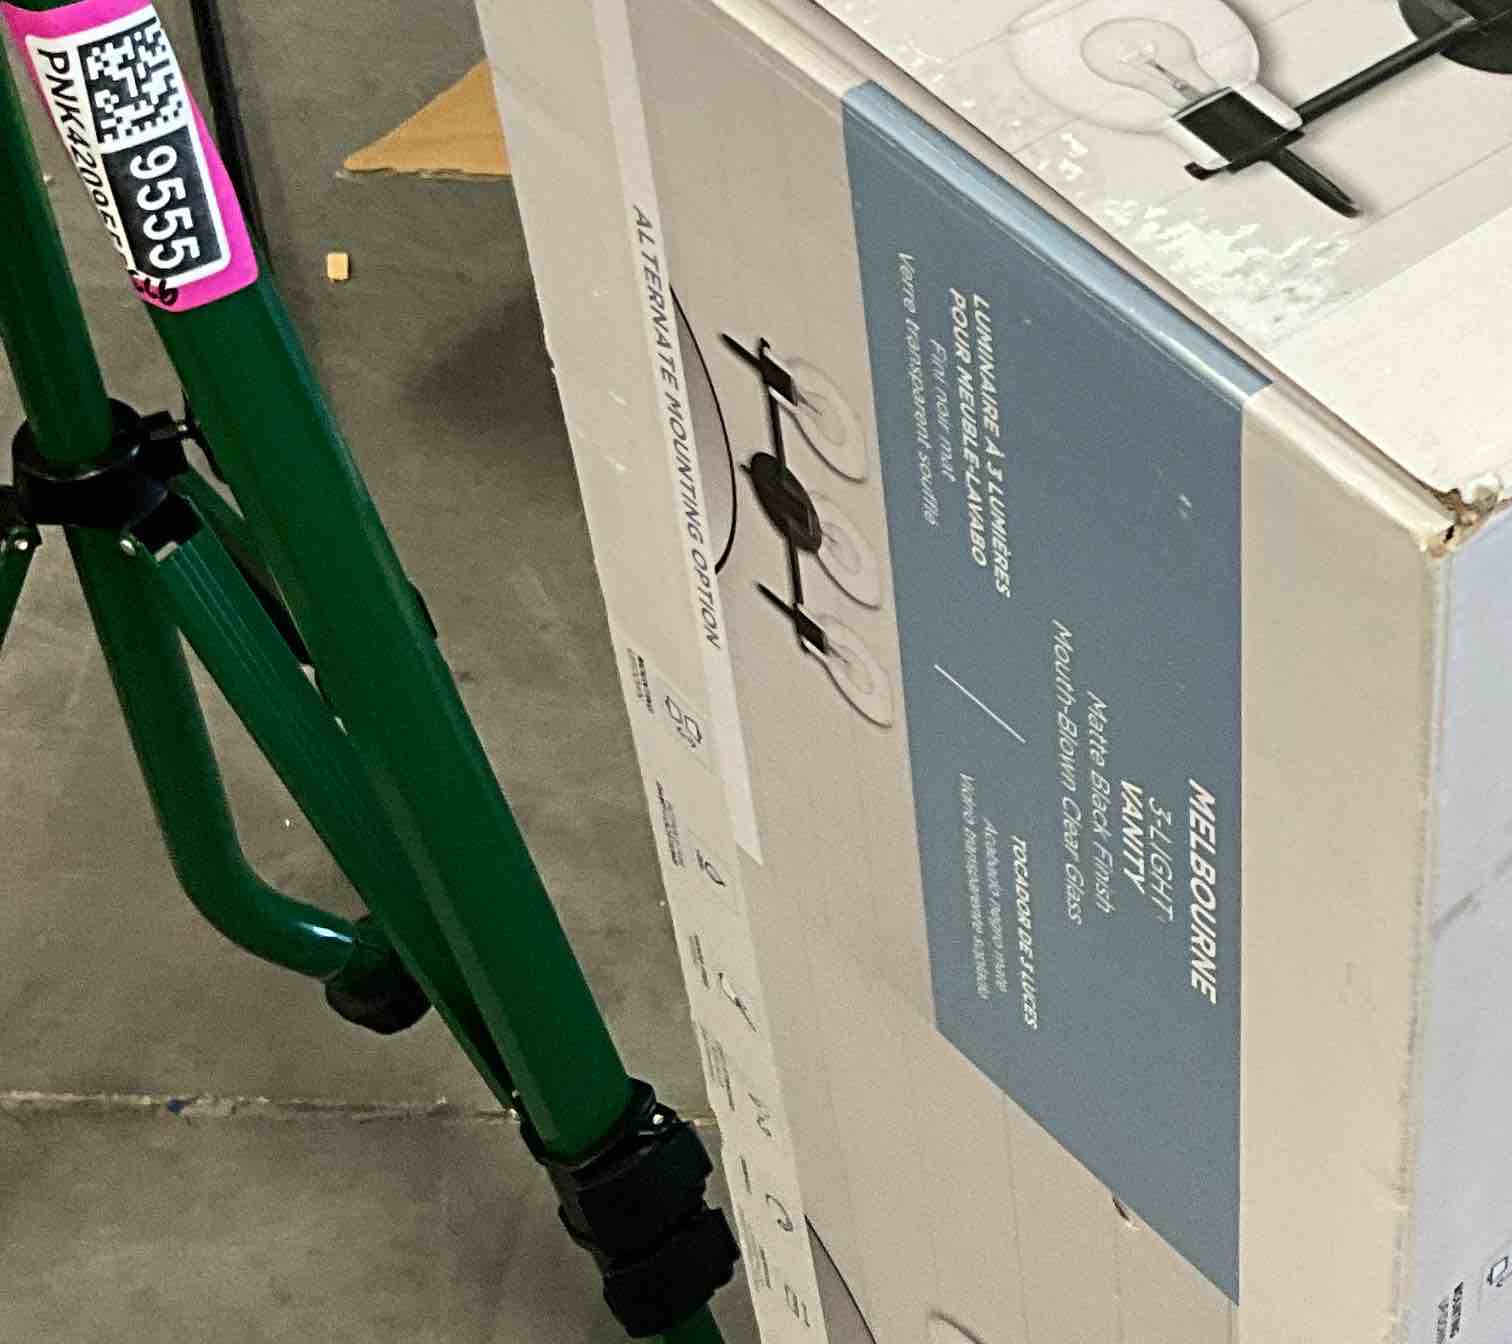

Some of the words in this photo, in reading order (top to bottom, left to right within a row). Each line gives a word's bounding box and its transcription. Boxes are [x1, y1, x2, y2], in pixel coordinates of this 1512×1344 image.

[129, 144, 201, 270] 9555
[898, 246, 918, 319] Verre
[929, 335, 948, 393] Fini
[950, 286, 970, 363] POUR
[972, 290, 998, 438] LUMINAIRE
[902, 312, 930, 453] transparent
[934, 387, 952, 436] noir
[633, 202, 678, 393] ALTERNATE
[664, 389, 704, 548] MOUNTING
[690, 544, 721, 652] OPTION
[938, 431, 956, 486] mat
[956, 364, 986, 571] MEUBLE-LAVABO
[983, 433, 1003, 466] À
[917, 447, 938, 532] soufflé
[985, 457, 1002, 483] 3
[987, 477, 1012, 603] LUMIÈRES
[1052, 617, 1078, 798] Mouth-Blown
[1086, 688, 1108, 773] Matte
[1061, 791, 1081, 864] Clear
[1089, 765, 1110, 845] Black
[1119, 771, 1144, 895] VANITY
[1010, 829, 1030, 931] TOCADOR
[1065, 857, 1084, 930] Glass
[1093, 838, 1113, 919] Finish
[1148, 793, 1172, 922] 3-LIGHT
[1188, 776, 1216, 1006] MELBOURNE
[1017, 924, 1032, 961] DE
[1019, 953, 1033, 974] 3
[1020, 967, 1037, 1033] LUCES
